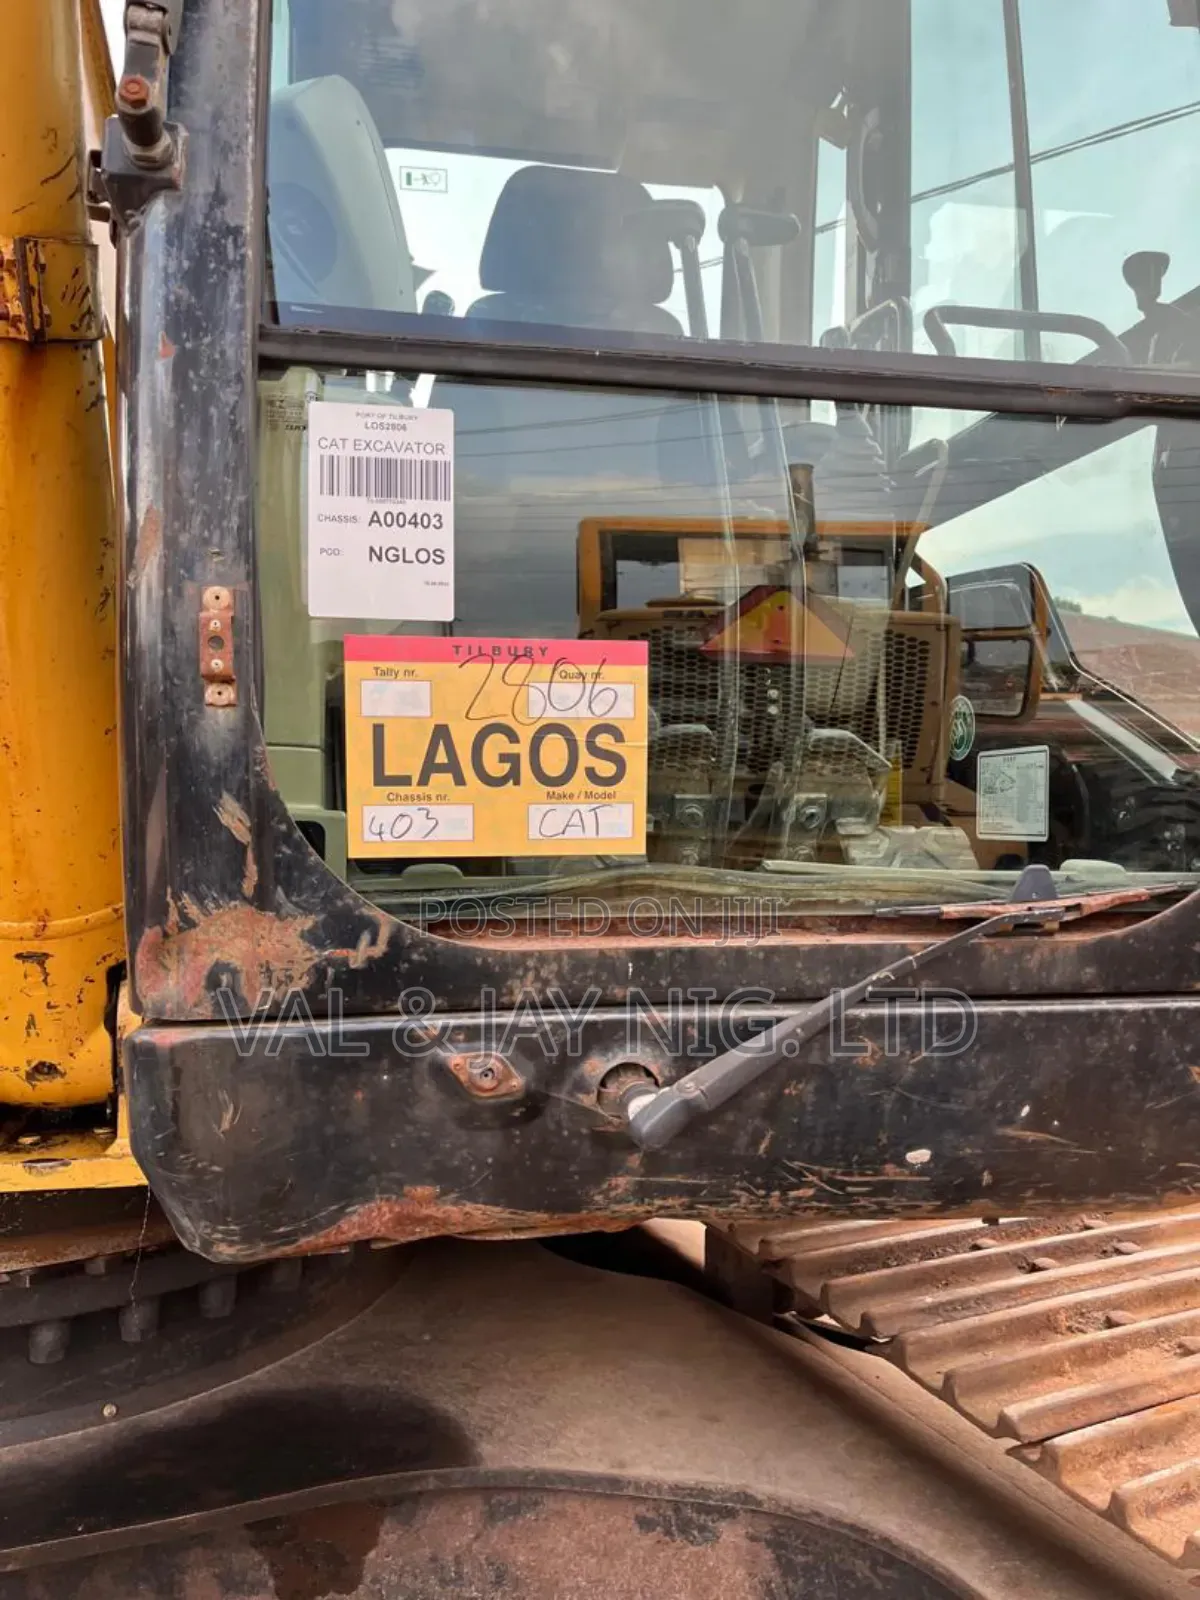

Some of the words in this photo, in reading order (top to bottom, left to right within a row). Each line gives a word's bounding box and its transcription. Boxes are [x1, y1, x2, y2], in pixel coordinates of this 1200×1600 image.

[317, 437, 348, 451] CAT
[353, 438, 446, 456] EXCAVATOR
[317, 514, 361, 524] CHASSIS:
[368, 510, 443, 530] A00403
[368, 545, 446, 565] NGLOS
[452, 645, 549, 657] TILBURY
[373, 666, 400, 678] Tally
[403, 669, 418, 678] nr.
[559, 669, 586, 680] Quay
[459, 653, 619, 726] 2806
[372, 722, 628, 788] LAGOS
[386, 792, 432, 802] Chassis
[435, 793, 451, 802] nr.
[546, 790, 575, 801] Make
[584, 790, 617, 801] Model
[369, 807, 439, 842] 403
[539, 804, 612, 838] CAT
